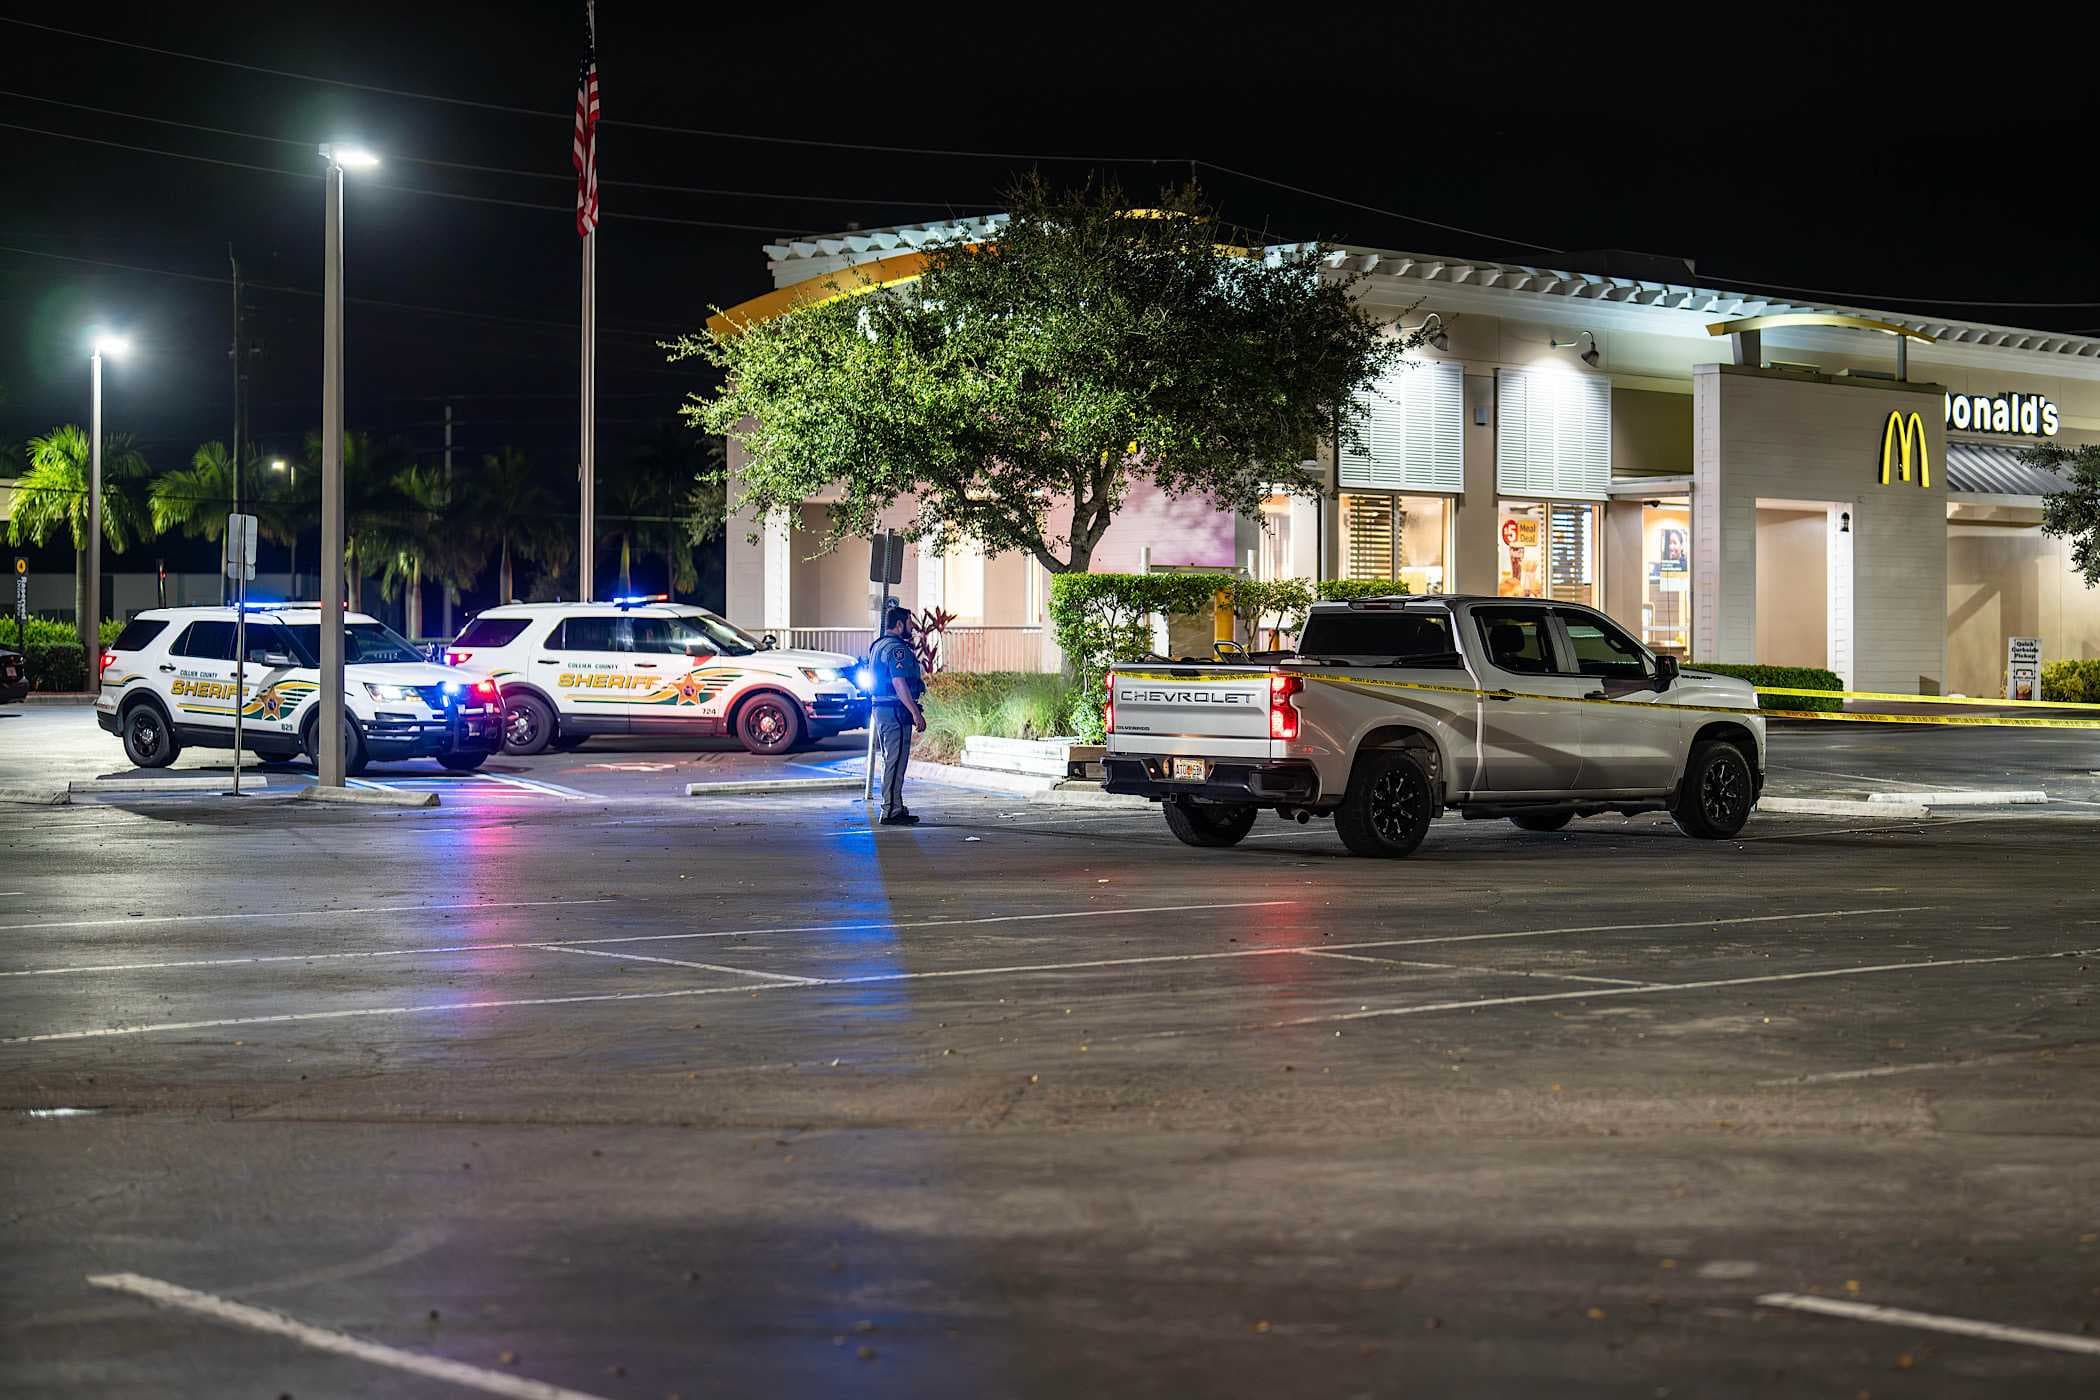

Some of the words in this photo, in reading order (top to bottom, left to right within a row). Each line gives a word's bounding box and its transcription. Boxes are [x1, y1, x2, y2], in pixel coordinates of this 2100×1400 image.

[1945, 392, 2059, 436] onald's
[1520, 523, 1536, 533] Meal
[1520, 534, 1536, 543] Deal
[558, 672, 662, 690] SHERIFF
[1120, 690, 1257, 704] CHEVROLET
